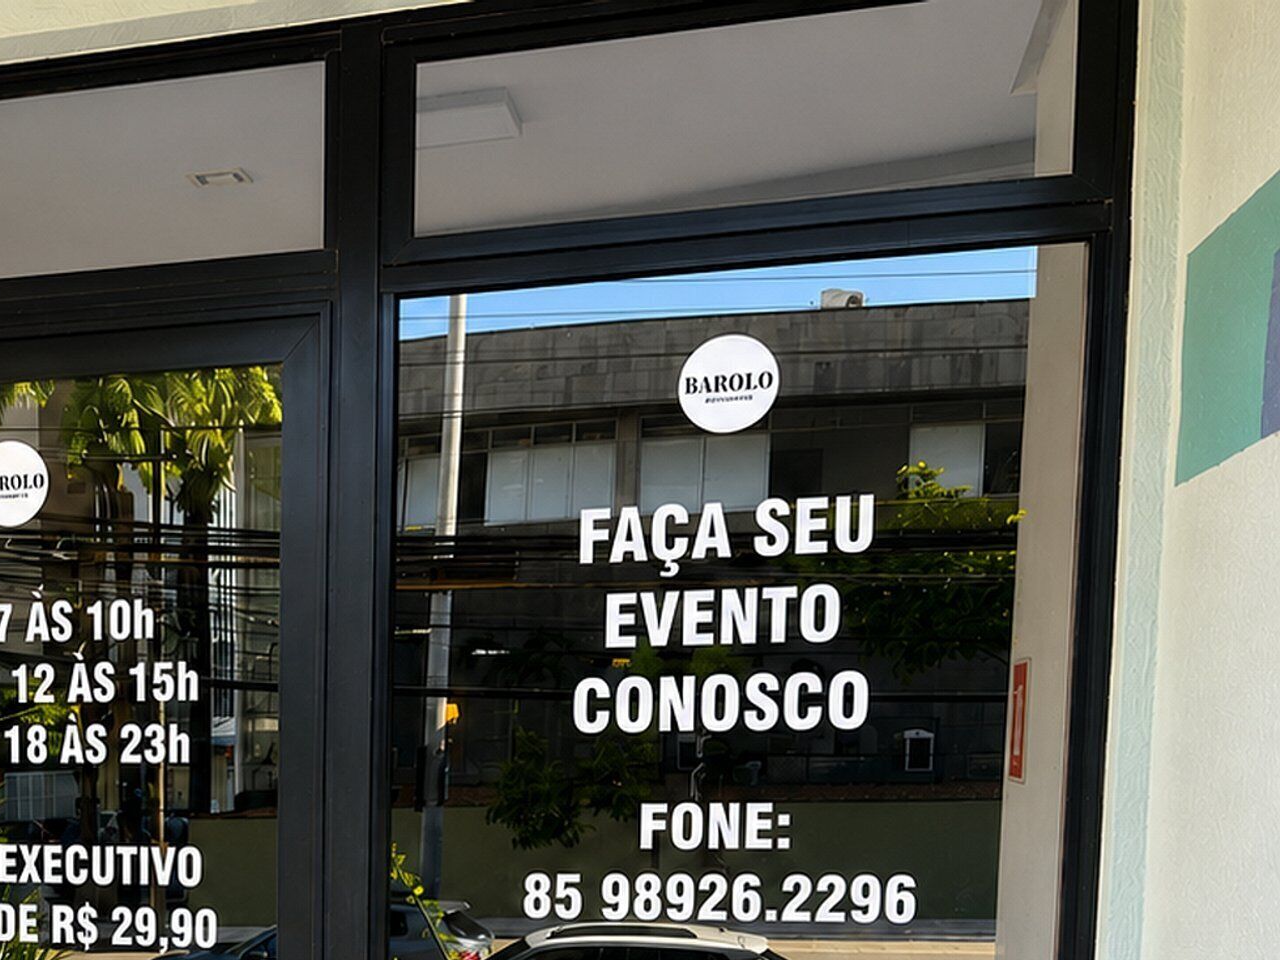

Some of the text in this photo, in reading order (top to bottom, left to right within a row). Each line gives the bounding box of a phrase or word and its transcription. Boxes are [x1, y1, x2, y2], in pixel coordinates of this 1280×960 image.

[685, 371, 774, 395] BAROLO
[578, 494, 875, 577] FAÇA SEU
[25, 590, 73, 642] ÀS
[86, 599, 154, 641] 10h
[604, 582, 842, 649] EVENTO
[10, 663, 55, 703] 12
[67, 650, 116, 703] ÀS
[129, 661, 199, 702] 15h
[572, 669, 870, 735] CONOSCO
[4, 724, 48, 764] 18
[61, 712, 107, 765] ÀS
[120, 723, 190, 764] 23h
[639, 802, 792, 851] FONE:
[522, 872, 918, 926] 85 98926.2296
[51, 903, 99, 952] R$
[111, 906, 218, 954] 29,90
